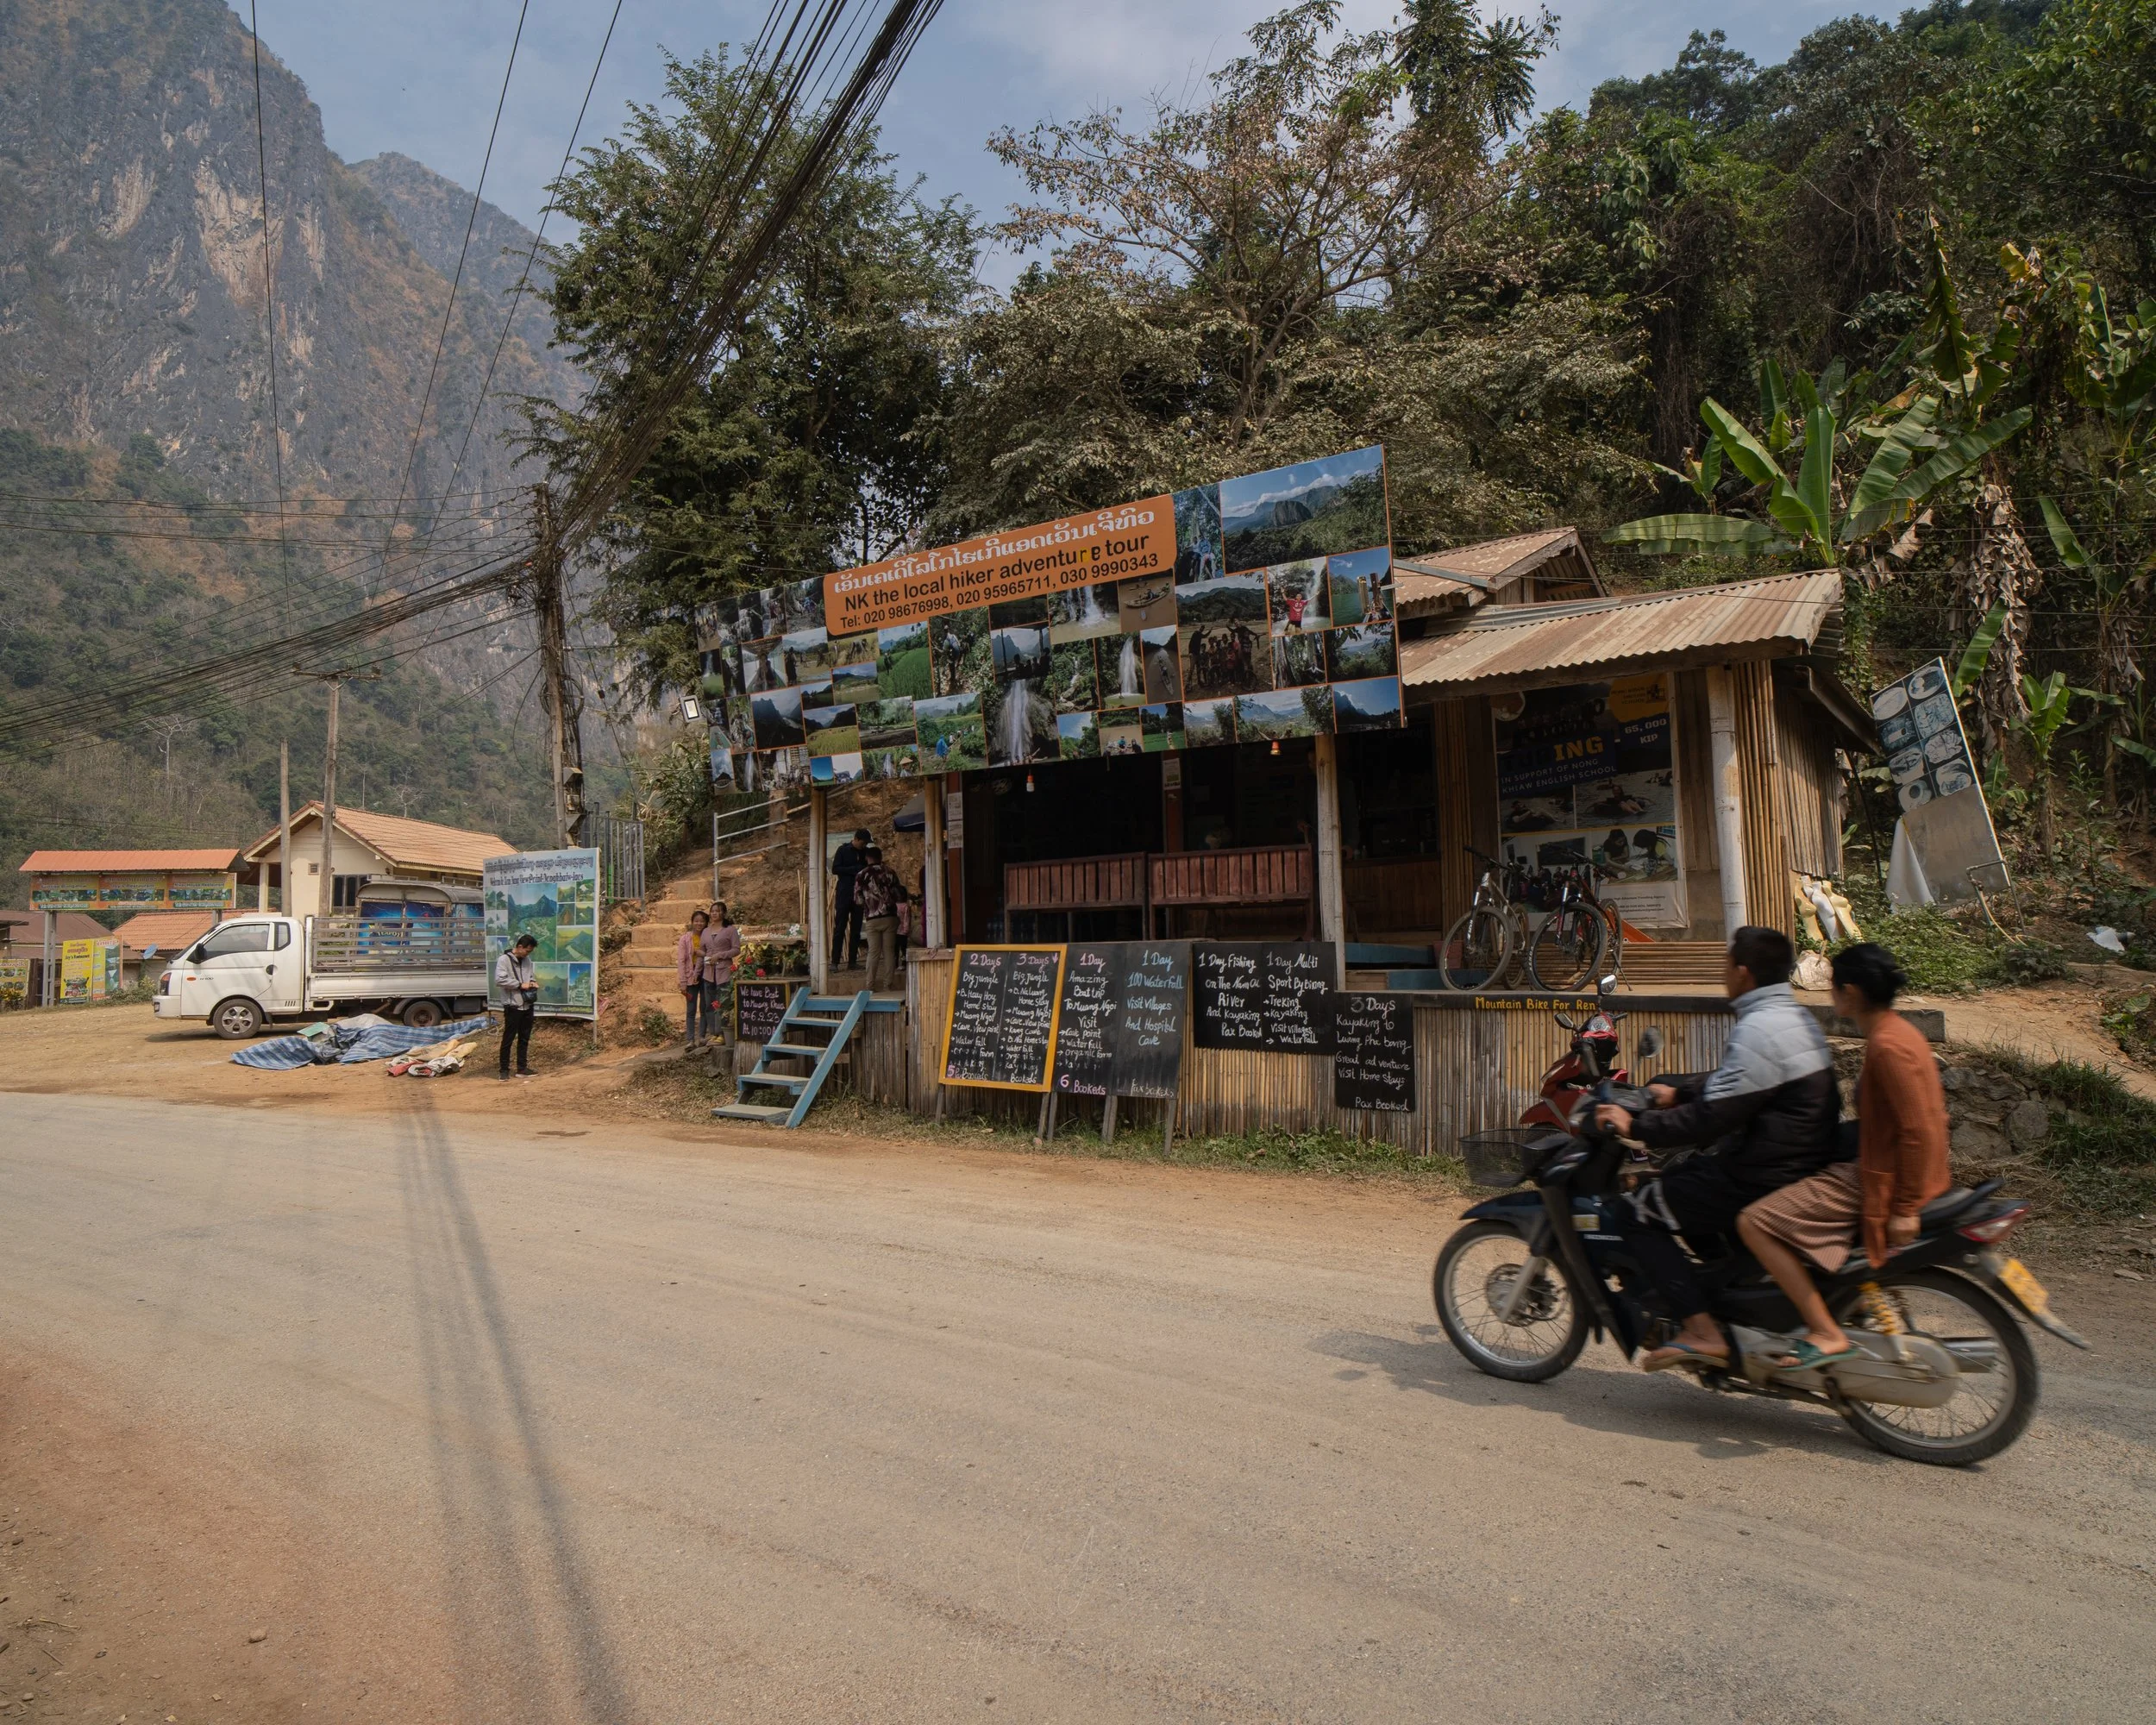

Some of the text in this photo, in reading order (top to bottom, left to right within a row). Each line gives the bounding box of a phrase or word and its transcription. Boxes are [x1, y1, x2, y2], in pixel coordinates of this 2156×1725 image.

[845, 535, 1150, 612] NK the local hiker adventure tour
[840, 553, 1158, 630] Tel: 020 98676998, 020 95965711, 030 9990343
[1639, 733, 1658, 744] KIP
[1501, 758, 1598, 785] IN SUPPORT OF NONG
[1501, 765, 1617, 794] KHIAW ENGLISH SCHOOL
[969, 953, 1002, 973] 2 Days
[1016, 953, 1049, 974] 3 Days
[1080, 952, 1106, 973] 1 Day
[1141, 949, 1175, 972] 1 Day
[1198, 952, 1206, 968] 1
[1208, 953, 1227, 974] Day
[1266, 951, 1274, 967] 1
[1275, 956, 1294, 975] Day
[962, 971, 975, 988] Big
[1012, 971, 1025, 985] Big
[1068, 969, 1109, 988] Amazing
[1268, 974, 1293, 992] Sport
[1073, 985, 1091, 997] Boat
[1126, 995, 1144, 1010] Visit
[1365, 997, 1396, 1019] Days
[1475, 996, 1598, 1010] Mountain Bike For Ren
[1206, 1006, 1222, 1018] And
[1078, 1015, 1098, 1029] Visit
[1125, 1016, 1142, 1032] And
[1138, 1034, 1161, 1046] Cave
[947, 1064, 956, 1077] 5
[1060, 1074, 1070, 1088] 6
